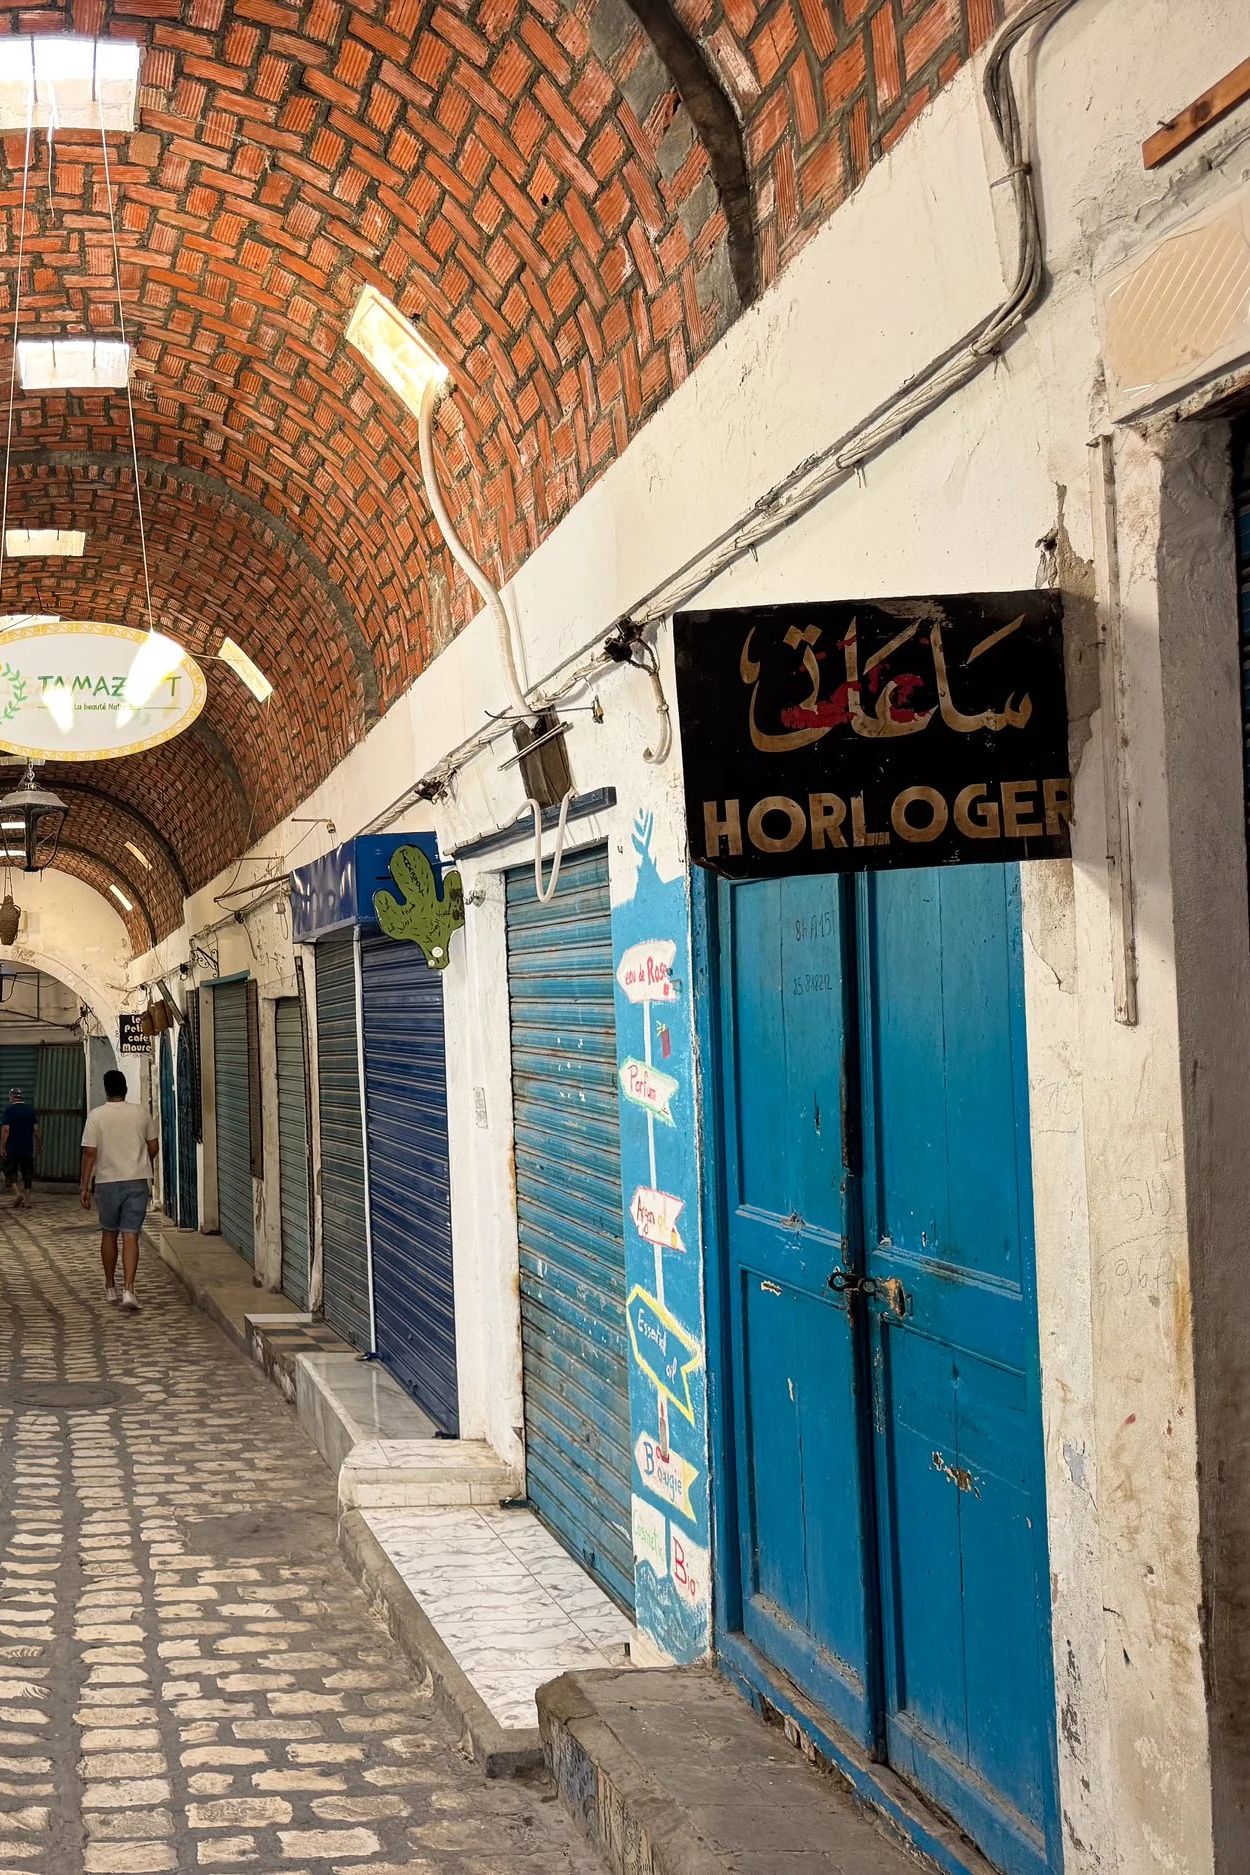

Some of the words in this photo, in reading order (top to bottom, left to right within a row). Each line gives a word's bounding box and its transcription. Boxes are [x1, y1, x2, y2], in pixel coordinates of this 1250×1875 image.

[37, 675, 182, 697] TAMAZT
[84, 702, 106, 711] beauté
[124, 1024, 143, 1033] Peti
[123, 1043, 151, 1052] Maure
[628, 1064, 657, 1101] Parfum
[643, 1441, 682, 1503] Bougie
[672, 1536, 696, 1596] Bio
